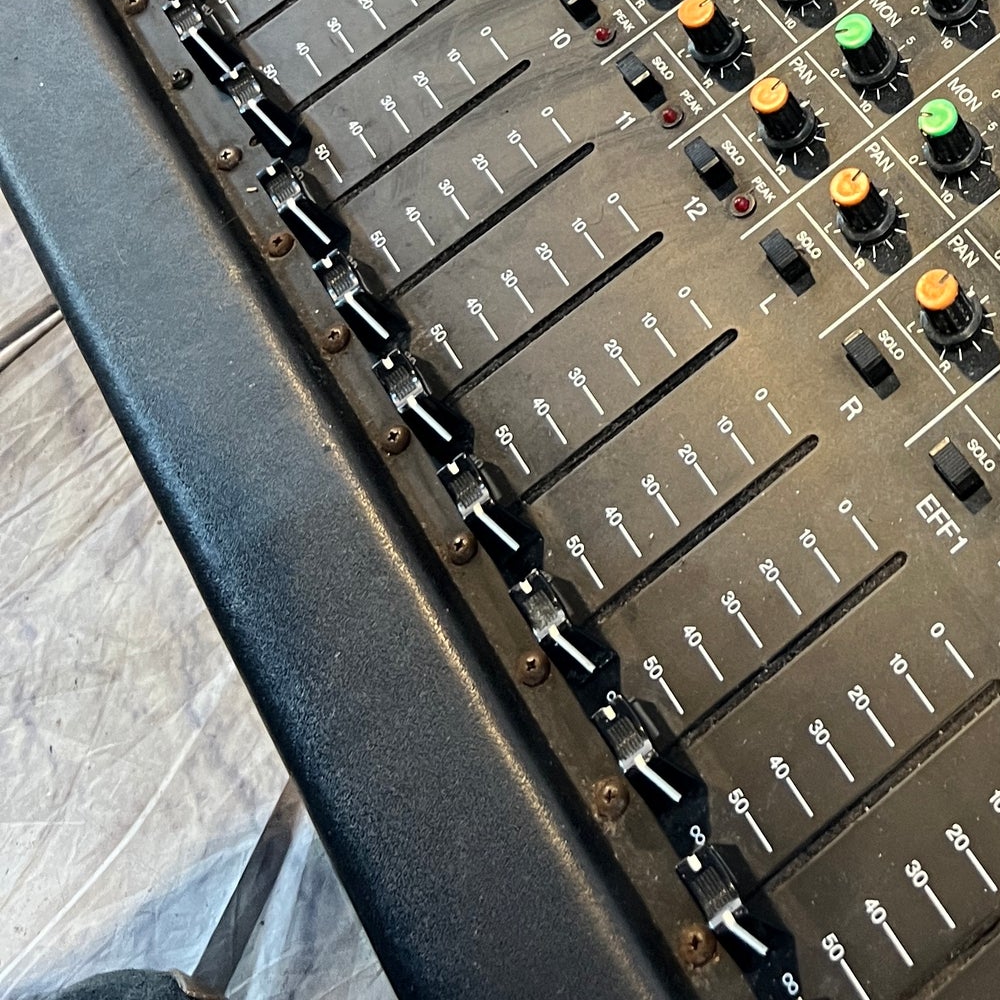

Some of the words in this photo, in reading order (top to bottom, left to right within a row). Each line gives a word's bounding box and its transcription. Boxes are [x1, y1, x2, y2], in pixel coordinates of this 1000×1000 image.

[480, 25, 493, 38] 0
[613, 9, 635, 33] PEAK
[550, 28, 571, 49] 10
[447, 49, 461, 64] 10
[652, 55, 675, 81] SOLO
[413, 70, 430, 88] 20
[788, 56, 817, 86] PAN
[380, 94, 397, 112] 30
[679, 89, 702, 115] PEAK
[947, 76, 984, 112] MON
[348, 120, 364, 137] 40
[615, 110, 637, 131] 11
[314, 143, 331, 160] 50
[720, 138, 746, 167] SOLO
[866, 141, 895, 173] PAN
[751, 175, 777, 204] PEAK
[683, 196, 708, 221] 12
[796, 230, 823, 261] SOLO
[947, 234, 980, 269] PAN
[758, 293, 778, 315] L
[877, 328, 905, 362] SOLO
[839, 395, 865, 422] R
[966, 437, 997, 473] SOLO
[945, 823, 970, 853] 20
[905, 859, 930, 888] 30
[864, 898, 889, 926] 40
[821, 933, 847, 962] 50
